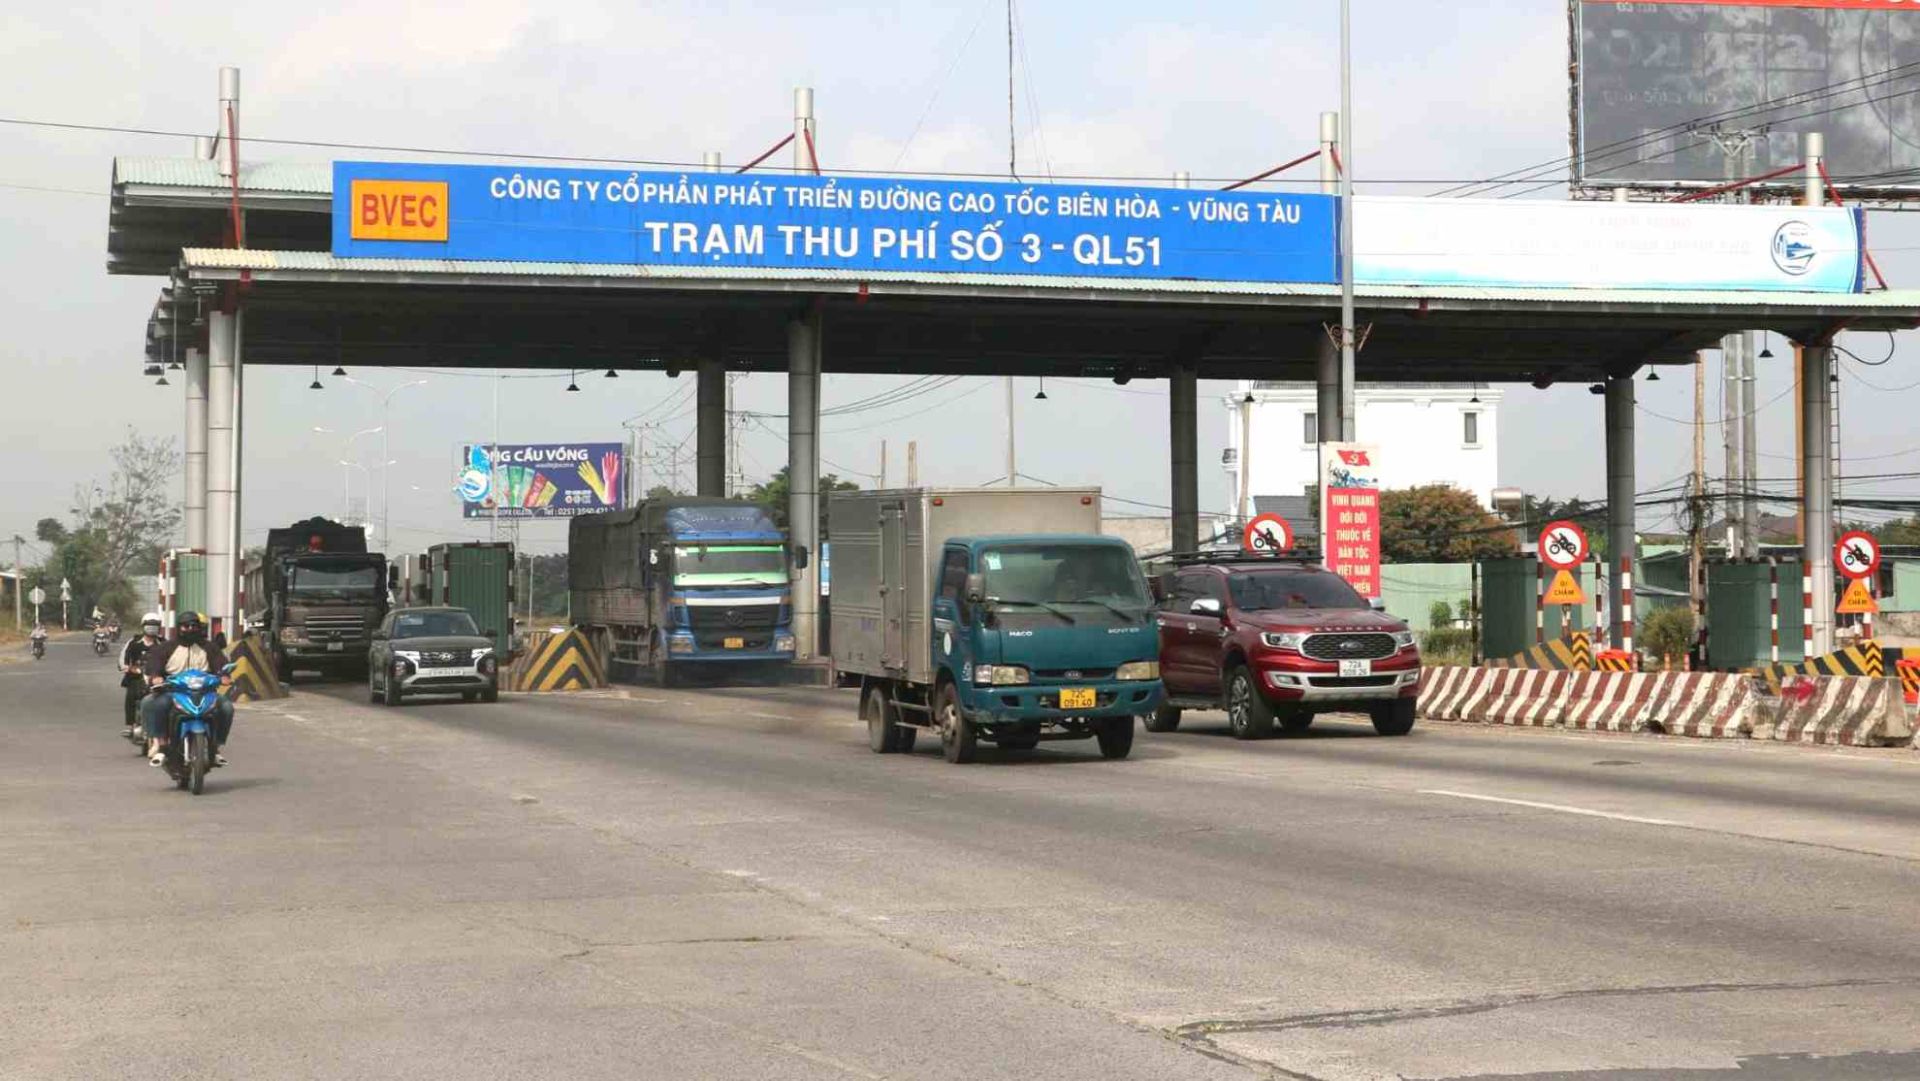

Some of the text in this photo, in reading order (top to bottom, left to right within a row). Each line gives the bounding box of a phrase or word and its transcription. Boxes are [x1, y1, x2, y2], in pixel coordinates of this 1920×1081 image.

[491, 174, 560, 199] CÔNG
[569, 181, 599, 200] TY
[606, 173, 640, 202] CỔ
[643, 175, 708, 205] PHẦN
[715, 182, 776, 206] PHÁT
[785, 179, 852, 208] TRIỂN
[859, 185, 941, 212] ĐƯỜNG
[949, 193, 995, 213] CAO
[1005, 187, 1048, 215] TỐC
[1058, 191, 1107, 217] BIÊN
[1116, 194, 1161, 219] HÒA
[1189, 198, 1249, 222] VŨNG
[1257, 200, 1300, 223] TÀU
[362, 194, 437, 227] BVEC
[645, 222, 763, 260] TRẠM
[778, 225, 858, 257] THU
[873, 222, 939, 259] PHÍ
[950, 220, 1004, 262] SỐ
[1021, 233, 1041, 262] 3
[1073, 233, 1161, 266] QL51
[1331, 494, 1375, 507] VINH QUANG
[1336, 529, 1360, 542] THUỘC
[1336, 563, 1371, 577] VIỆT NAM
